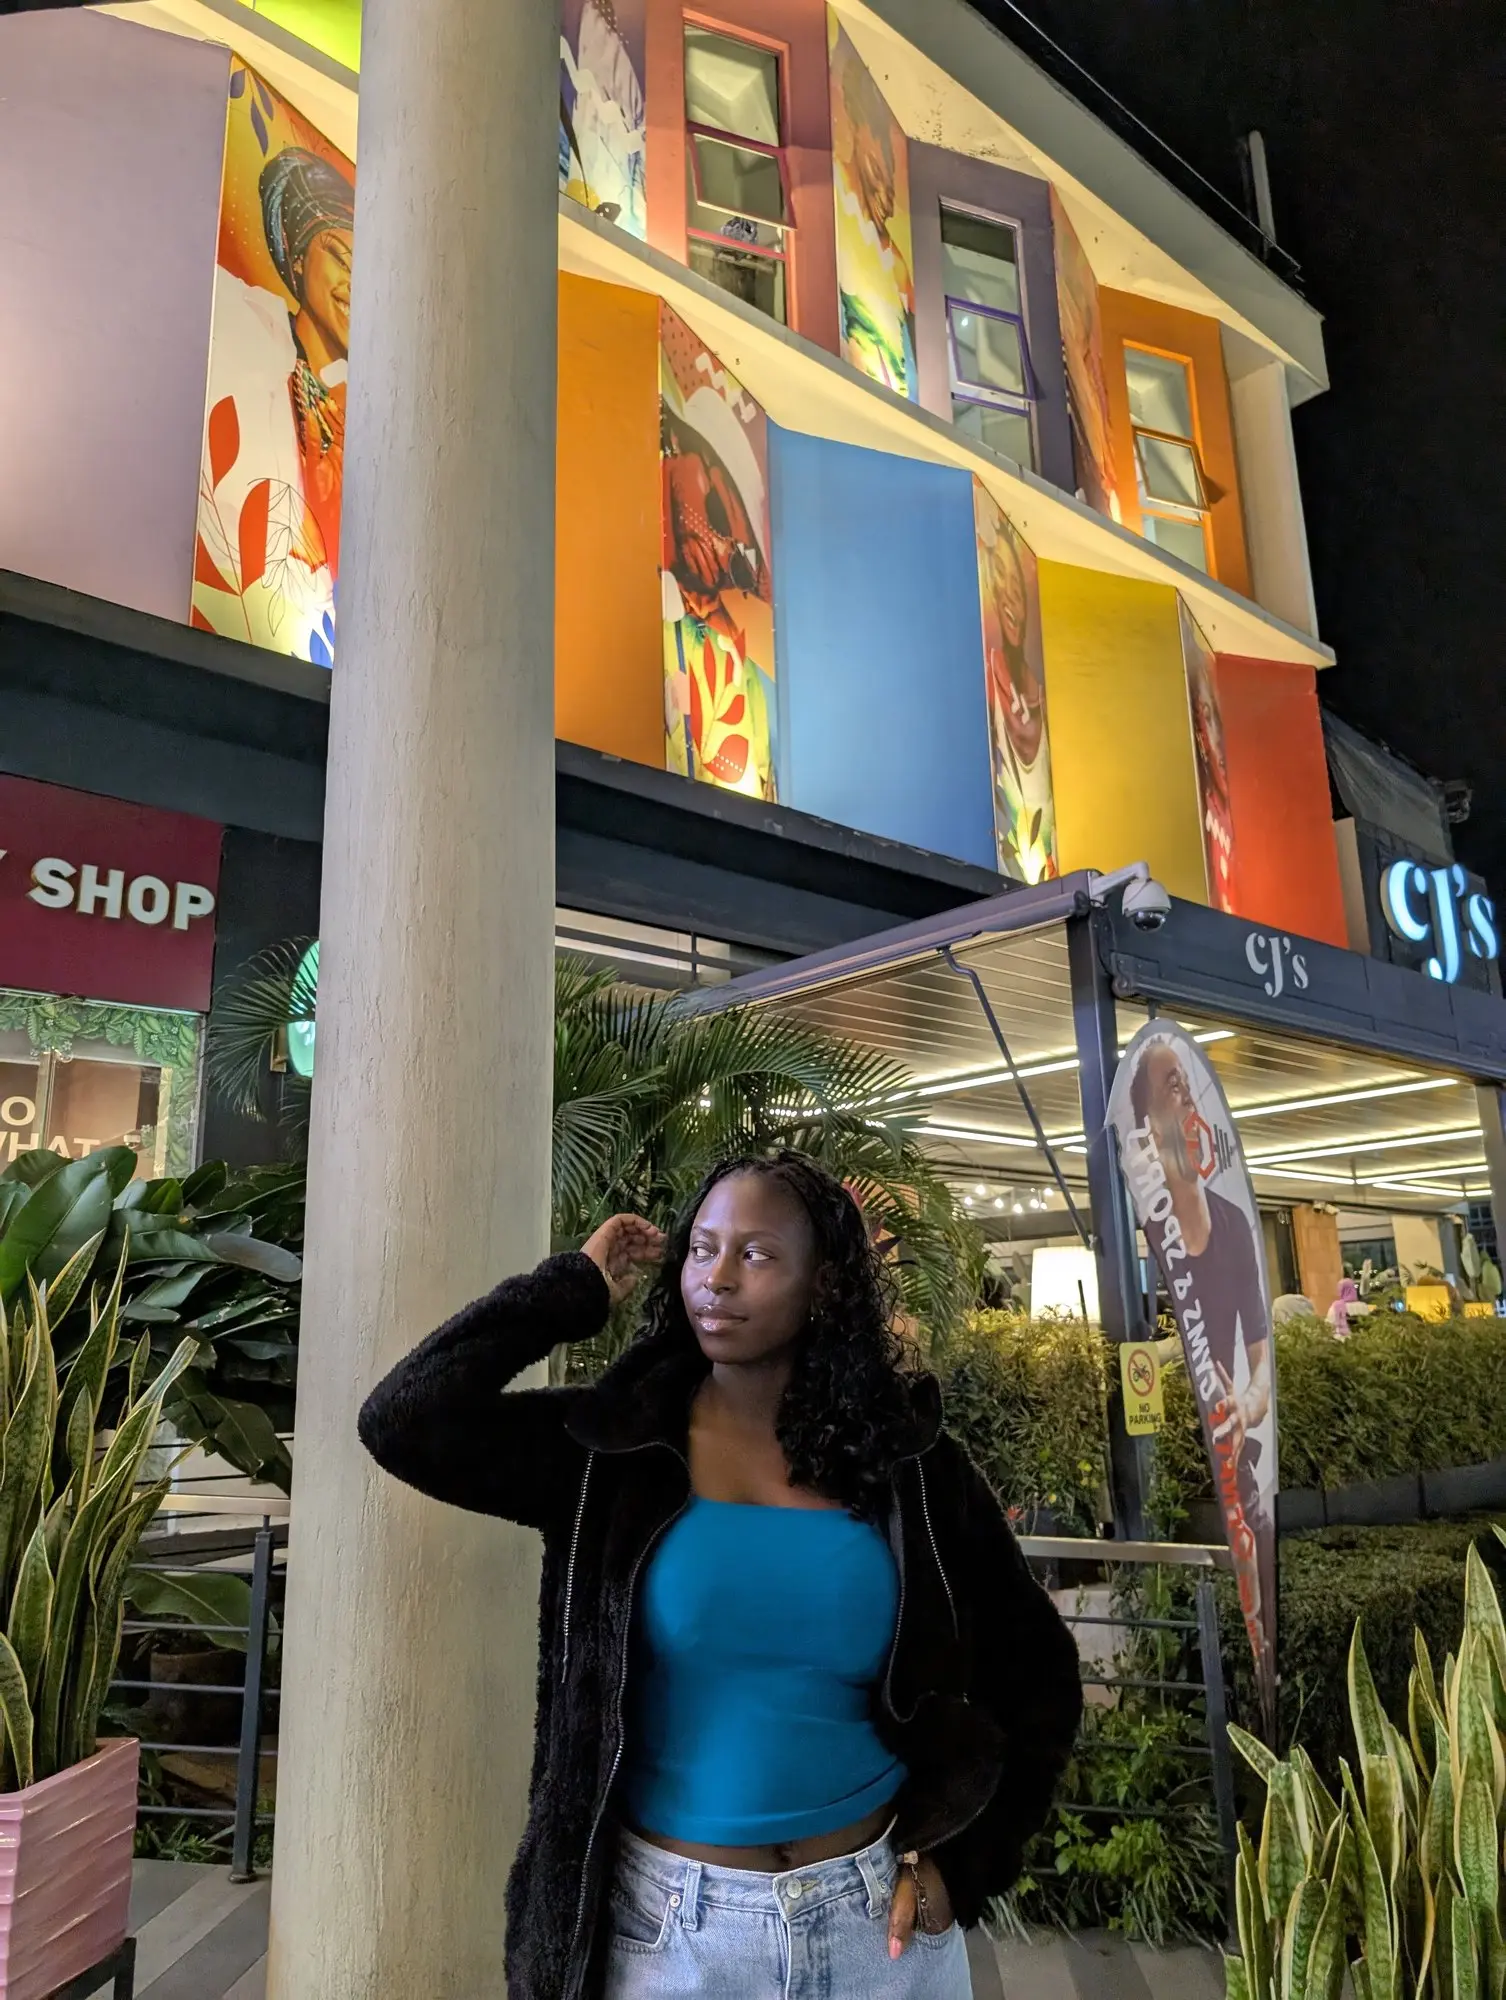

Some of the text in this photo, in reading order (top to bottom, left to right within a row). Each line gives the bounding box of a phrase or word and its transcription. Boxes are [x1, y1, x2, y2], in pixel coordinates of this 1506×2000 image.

[27, 857, 215, 931] SHOP
[0, 1131, 100, 1162] HAT
[1138, 1402, 1150, 1413] NO
[1129, 1413, 1161, 1425] PARKING
